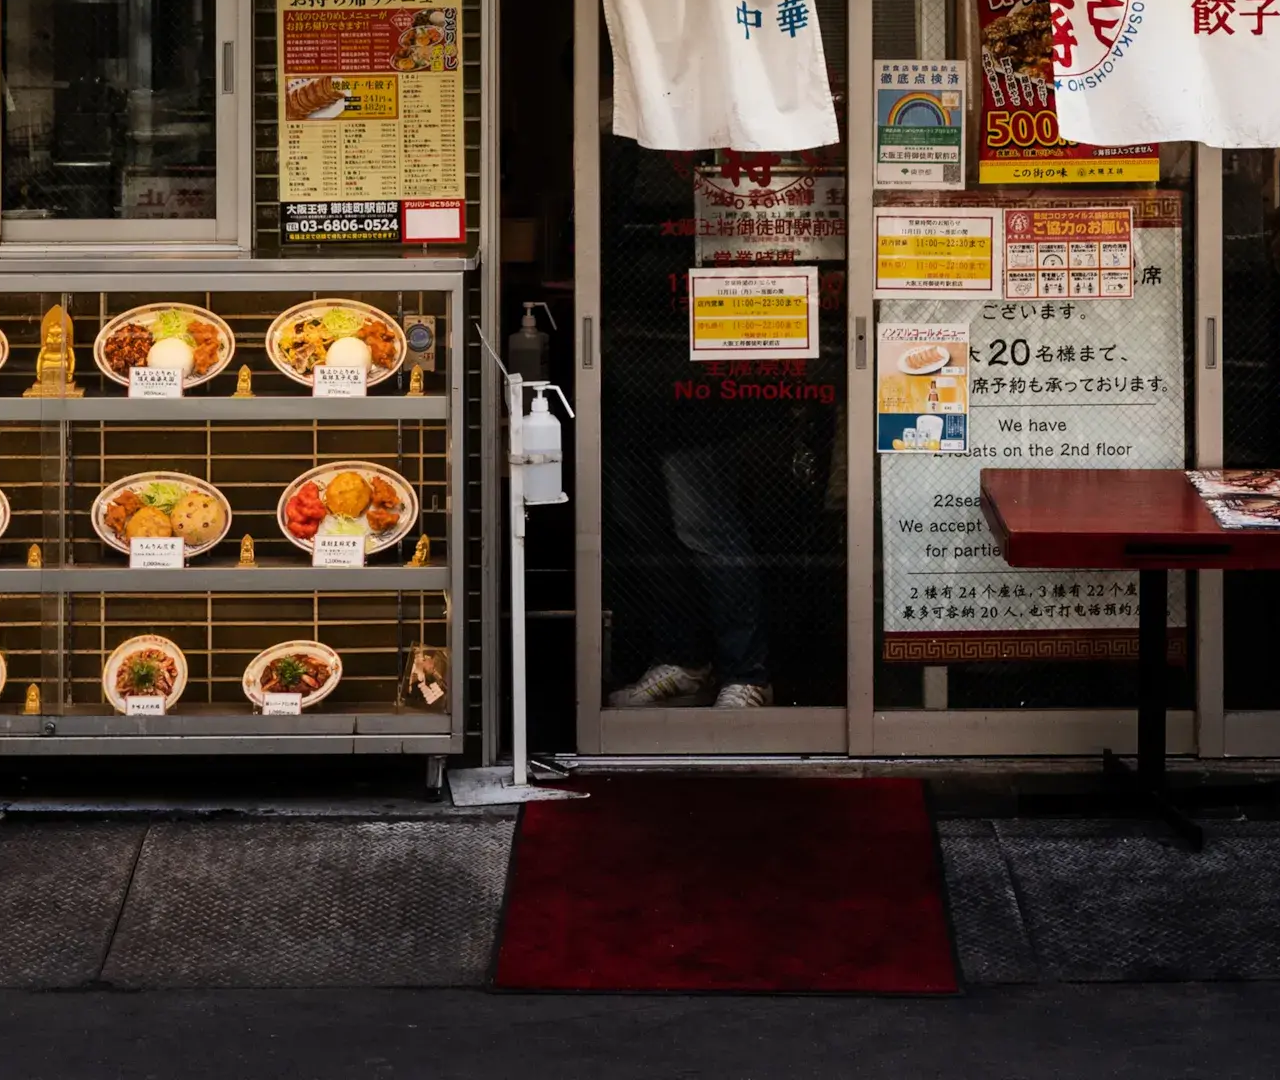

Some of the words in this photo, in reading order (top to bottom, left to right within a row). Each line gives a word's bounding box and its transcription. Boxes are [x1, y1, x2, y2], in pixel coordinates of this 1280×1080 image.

[287, 11, 387, 21] 人気のひとりめしメニューが
[881, 73, 959, 85] 徹底点検済
[987, 110, 1078, 147] 500
[881, 151, 957, 159] 大阪王将御徒町駅前店
[1013, 167, 1068, 179] この街の味
[286, 202, 328, 215] 大阪王将
[331, 201, 398, 214] 御徒町駅前店
[300, 219, 398, 232] 03-6806-0524
[1033, 220, 1129, 235] ご協力のお願い
[983, 304, 1086, 320] ございます。
[882, 328, 966, 337] ノンアルコールメニュー
[675, 380, 710, 401] No
[721, 379, 835, 404] Smoking
[999, 420, 1023, 432] We
[1029, 419, 1066, 432] have
[1003, 446, 1022, 457] on
[1029, 443, 1053, 457] the
[1060, 443, 1090, 456] 2nd
[1096, 443, 1132, 457] floor
[899, 520, 923, 532] We
[929, 520, 982, 535] accept
[926, 544, 948, 558] for
